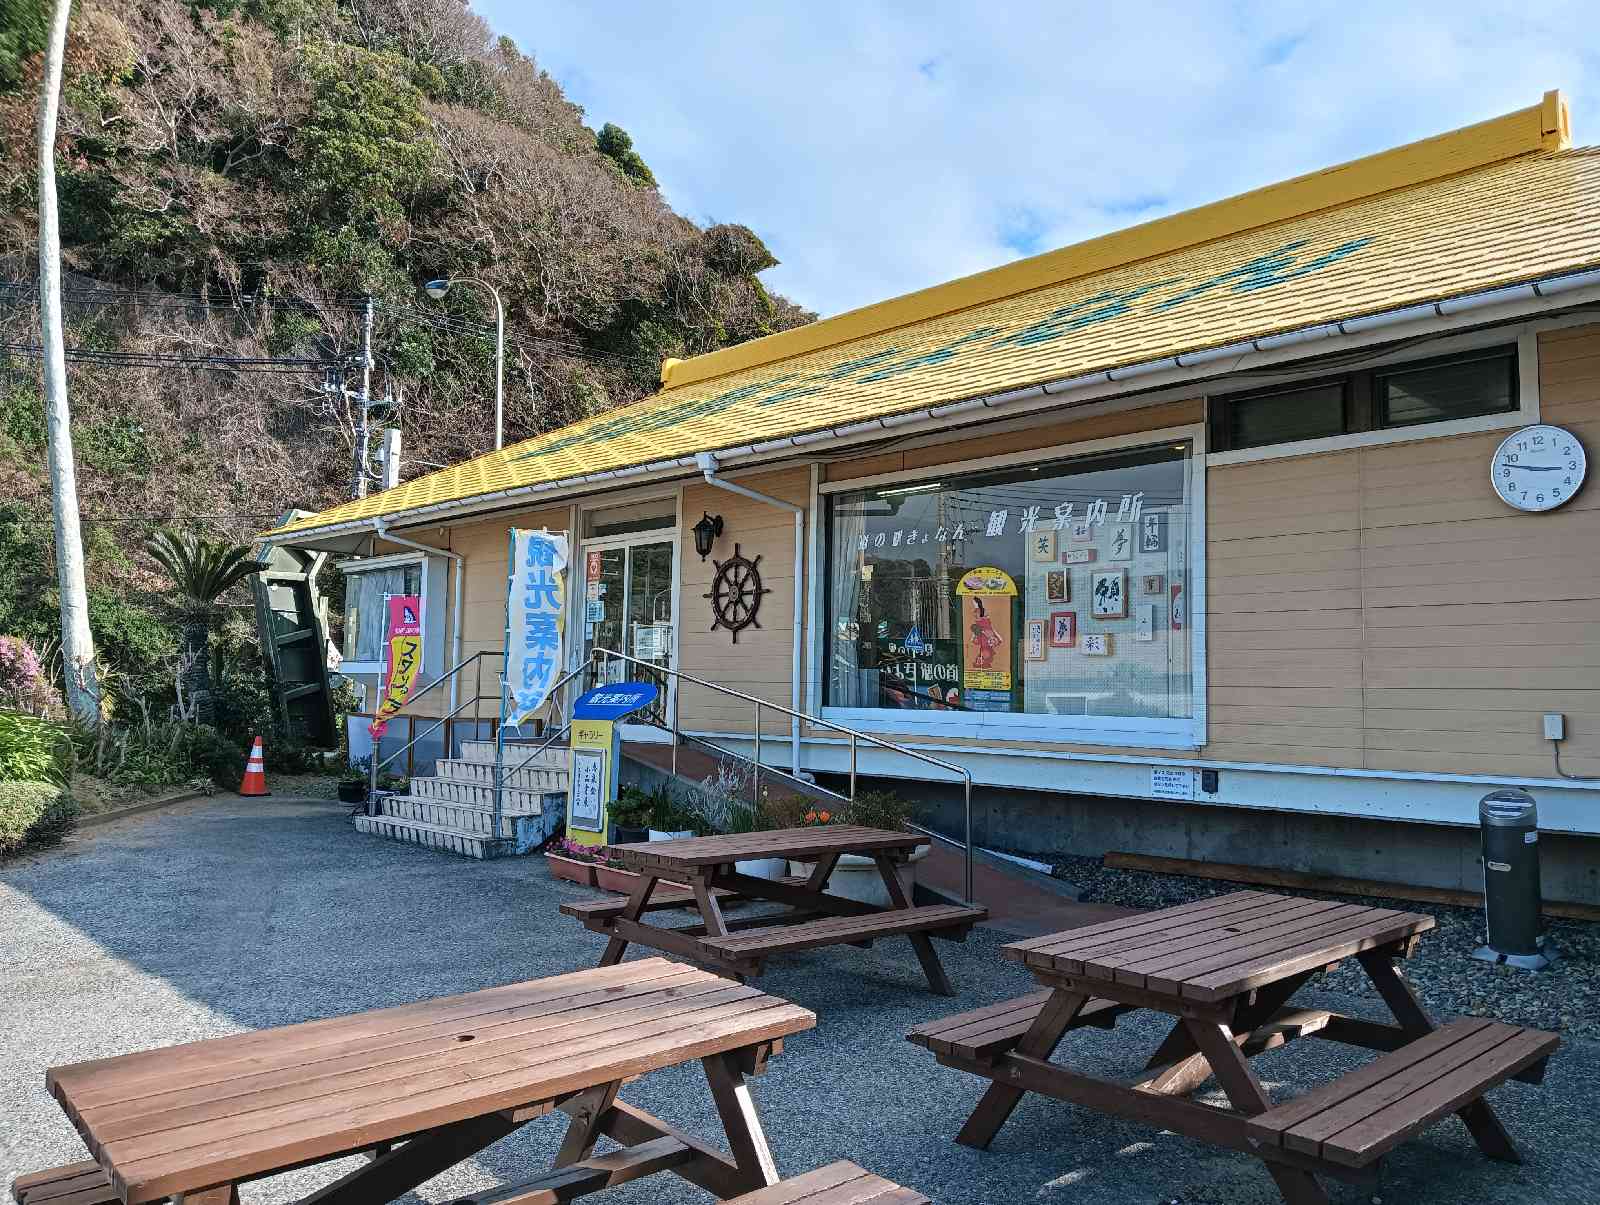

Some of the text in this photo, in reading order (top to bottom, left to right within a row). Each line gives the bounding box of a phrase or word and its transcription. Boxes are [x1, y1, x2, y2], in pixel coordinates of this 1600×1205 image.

[1532, 435, 1544, 446] 12
[1552, 438, 1557, 448] 1
[1519, 441, 1528, 452] 11
[1563, 446, 1571, 456] 2
[1506, 453, 1519, 464] 10
[1568, 460, 1577, 471] 3
[1503, 468, 1511, 478] 9
[1563, 476, 1572, 486] 4
[1508, 482, 1517, 492] 8
[1520, 491, 1528, 501] 7
[1552, 487, 1561, 498] 5
[1536, 493, 1545, 503] 6
[985, 491, 1144, 537] 観光案内所
